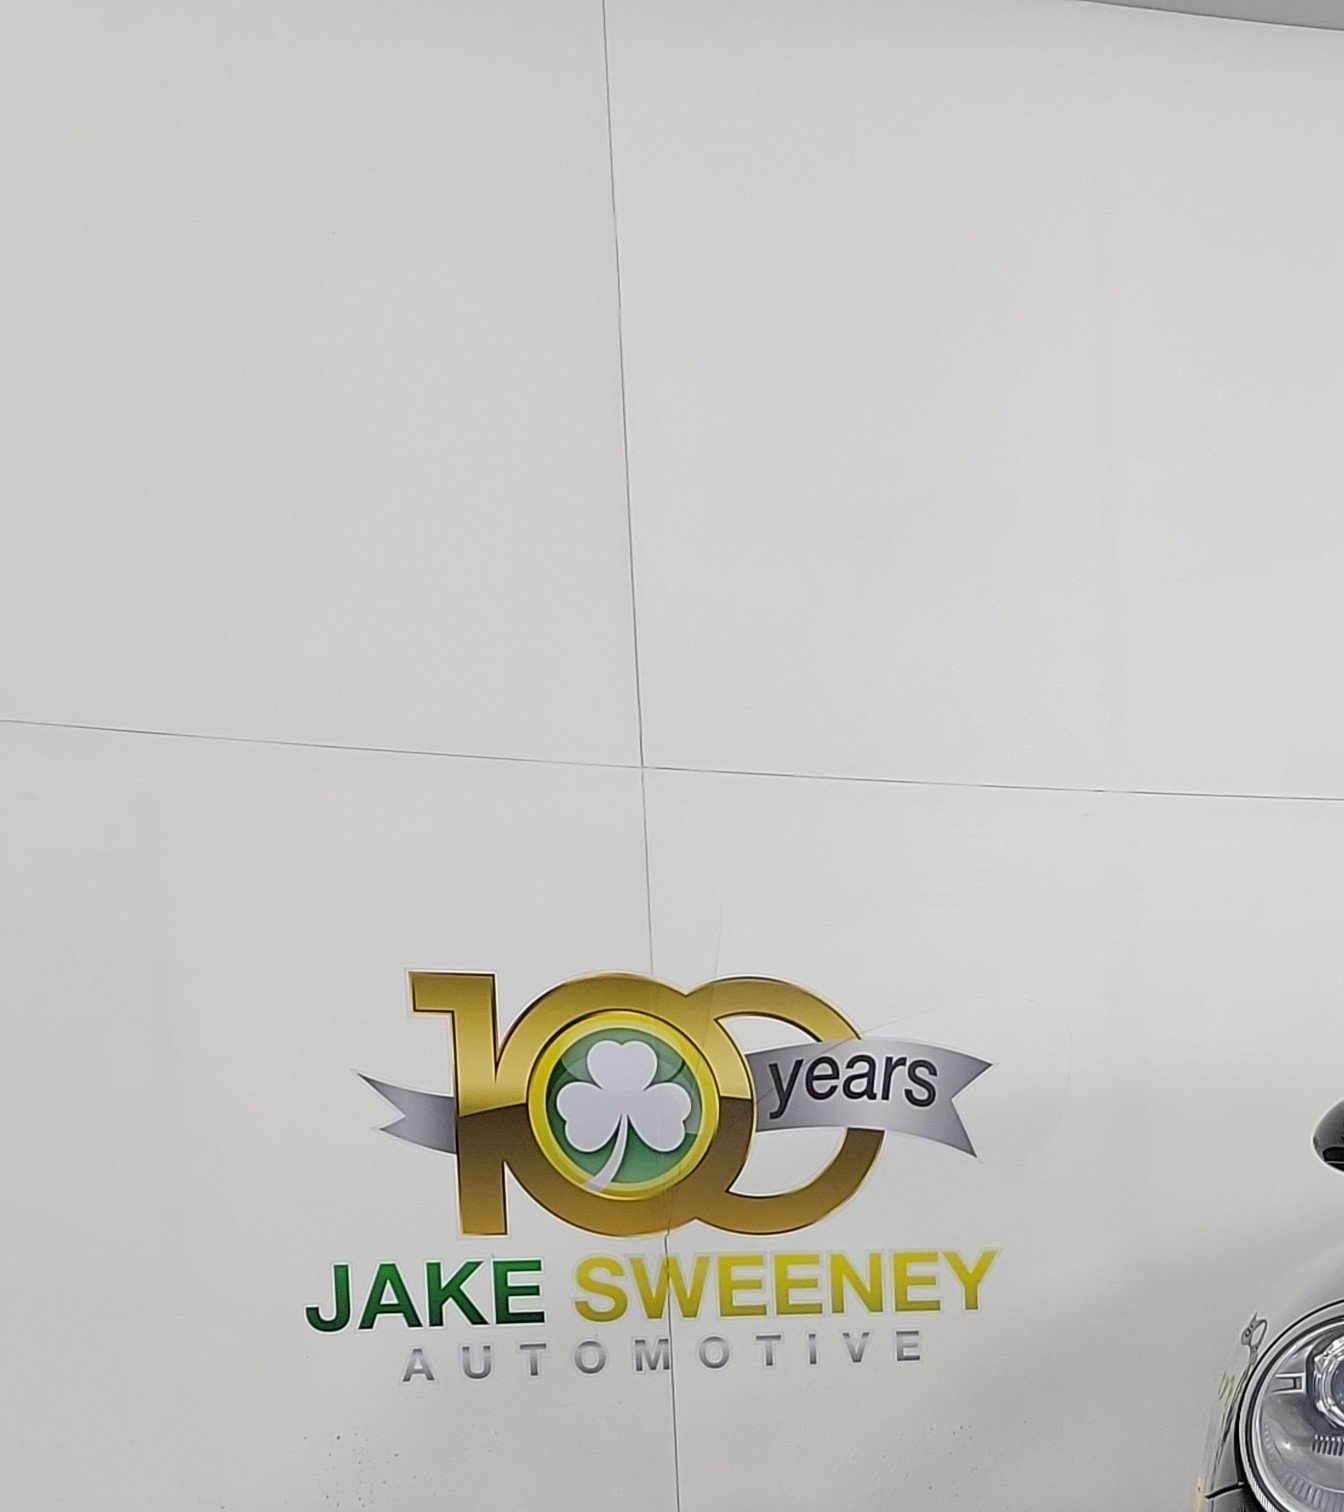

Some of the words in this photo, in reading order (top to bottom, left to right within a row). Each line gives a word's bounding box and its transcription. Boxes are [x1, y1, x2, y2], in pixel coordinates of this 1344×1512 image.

[408, 971, 886, 1237] 100
[768, 1053, 939, 1120] years
[305, 1258, 546, 1333] JAKE
[574, 1250, 998, 1323] SWEENEY
[402, 1330, 922, 1383] AUTOMOTIVE
